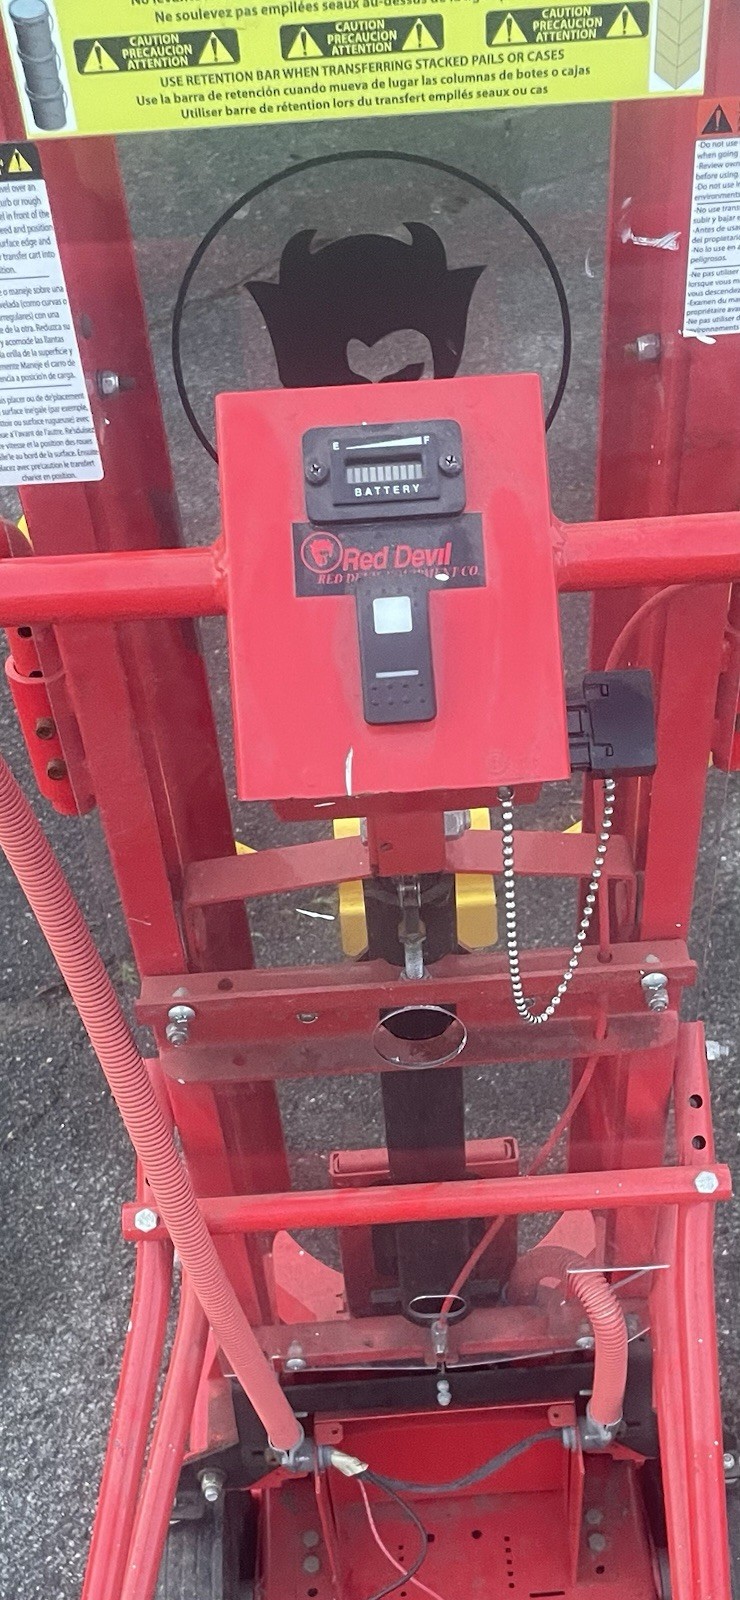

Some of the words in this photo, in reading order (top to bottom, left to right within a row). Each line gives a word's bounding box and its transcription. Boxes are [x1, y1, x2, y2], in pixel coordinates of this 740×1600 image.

[155, 11, 173, 23] Ne
[175, 8, 233, 21] soulevez
[236, 7, 258, 21] pas
[261, 1, 319, 16] empilées
[323, 1, 360, 11] seaux
[541, 6, 592, 19] CAUTION
[335, 19, 385, 33] CAUTION
[533, 17, 602, 32] PRECAUCION
[129, 34, 179, 46] CAUTION
[327, 30, 397, 45] PRECAUCION
[535, 29, 597, 43] ATTENTION
[122, 44, 193, 59] PRECAUCION
[332, 42, 392, 56] ATTENTION
[127, 56, 189, 71] ATTENTION
[160, 76, 183, 88] USE
[186, 71, 253, 86] RETENTION
[256, 68, 280, 81] BAR
[283, 66, 319, 79] WHEN
[323, 60, 412, 76] TRANSFERRING
[415, 56, 468, 70] STACKED
[472, 53, 504, 65] PAILS
[507, 52, 524, 63] OR
[527, 49, 565, 62] CASES
[136, 95, 158, 106] Use
[160, 94, 171, 105] la
[173, 91, 205, 103] barra
[207, 90, 222, 101] de
[225, 86, 281, 100] retención
[283, 82, 327, 96] cuando
[329, 82, 368, 92] mueva
[371, 78, 385, 89] de
[388, 76, 419, 91] lugar
[422, 75, 437, 86] las
[441, 71, 496, 84] columnas
[499, 69, 513, 80] de
[516, 67, 548, 79] botes
[561, 65, 590, 79] cajas
[181, 107, 222, 119] Utiliser
[225, 105, 257, 116] barre
[259, 102, 275, 114] de
[277, 99, 330, 113] rétention
[333, 98, 354, 109] lors
[357, 95, 372, 107] du
[376, 92, 425, 105] transfert
[428, 88, 473, 102] empilés
[476, 87, 510, 98] seaux
[512, 86, 527, 96] ou
[530, 85, 548, 95] cas
[712, 140, 724, 148] not
[696, 152, 716, 160] when
[717, 150, 738, 160] going
[695, 172, 718, 180] before
[709, 182, 721, 190] not
[31, 210, 38, 219] of
[39, 209, 50, 218] the
[692, 216, 711, 224] subir
[718, 215, 735, 223] bajar
[14, 224, 26, 233] and
[27, 224, 53, 235] position
[39, 237, 51, 245] and
[29, 251, 41, 259] cart
[42, 251, 56, 259] into
[33, 285, 51, 294] sobre
[698, 318, 711, 326] pas
[5, 325, 13, 333] de
[332, 442, 340, 450] E
[423, 436, 430, 444] F
[355, 484, 420, 497] BATTERY
[343, 546, 389, 571] Red
[394, 541, 452, 569] Devil
